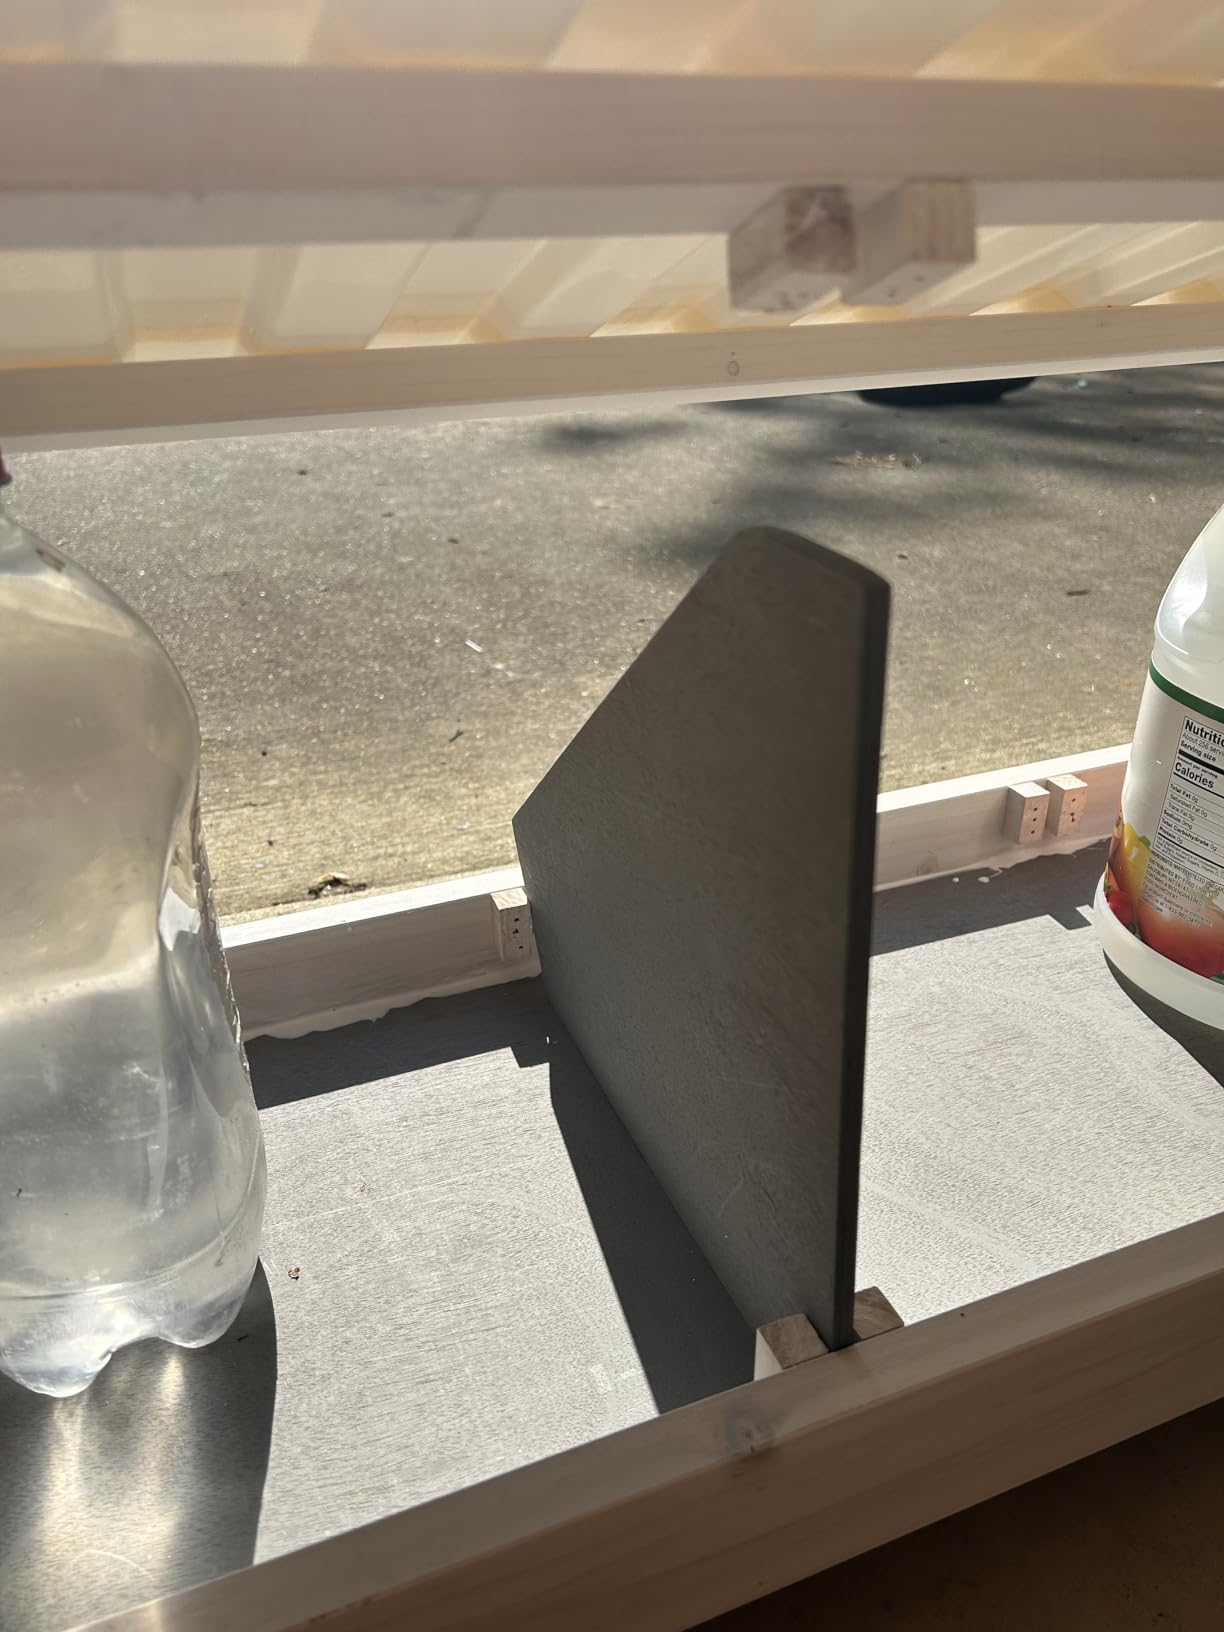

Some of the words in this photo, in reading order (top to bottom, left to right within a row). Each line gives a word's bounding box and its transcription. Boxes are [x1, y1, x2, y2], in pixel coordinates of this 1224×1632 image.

[1181, 740, 1202, 756] Serving
[1203, 752, 1216, 761] size
[1175, 762, 1214, 789] Calories
[1170, 783, 1182, 794] Total
[1182, 790, 1191, 798] Fat
[1191, 795, 1199, 803] 0g
[1170, 793, 1192, 809] Saturated
[1192, 805, 1201, 813] Fat
[1163, 809, 1181, 822] Sodium
[1180, 809, 1188, 817] Fat
[1159, 826, 1176, 840] Protein
[1161, 817, 1174, 828] Total
[1174, 824, 1209, 847] Carbohydrate
